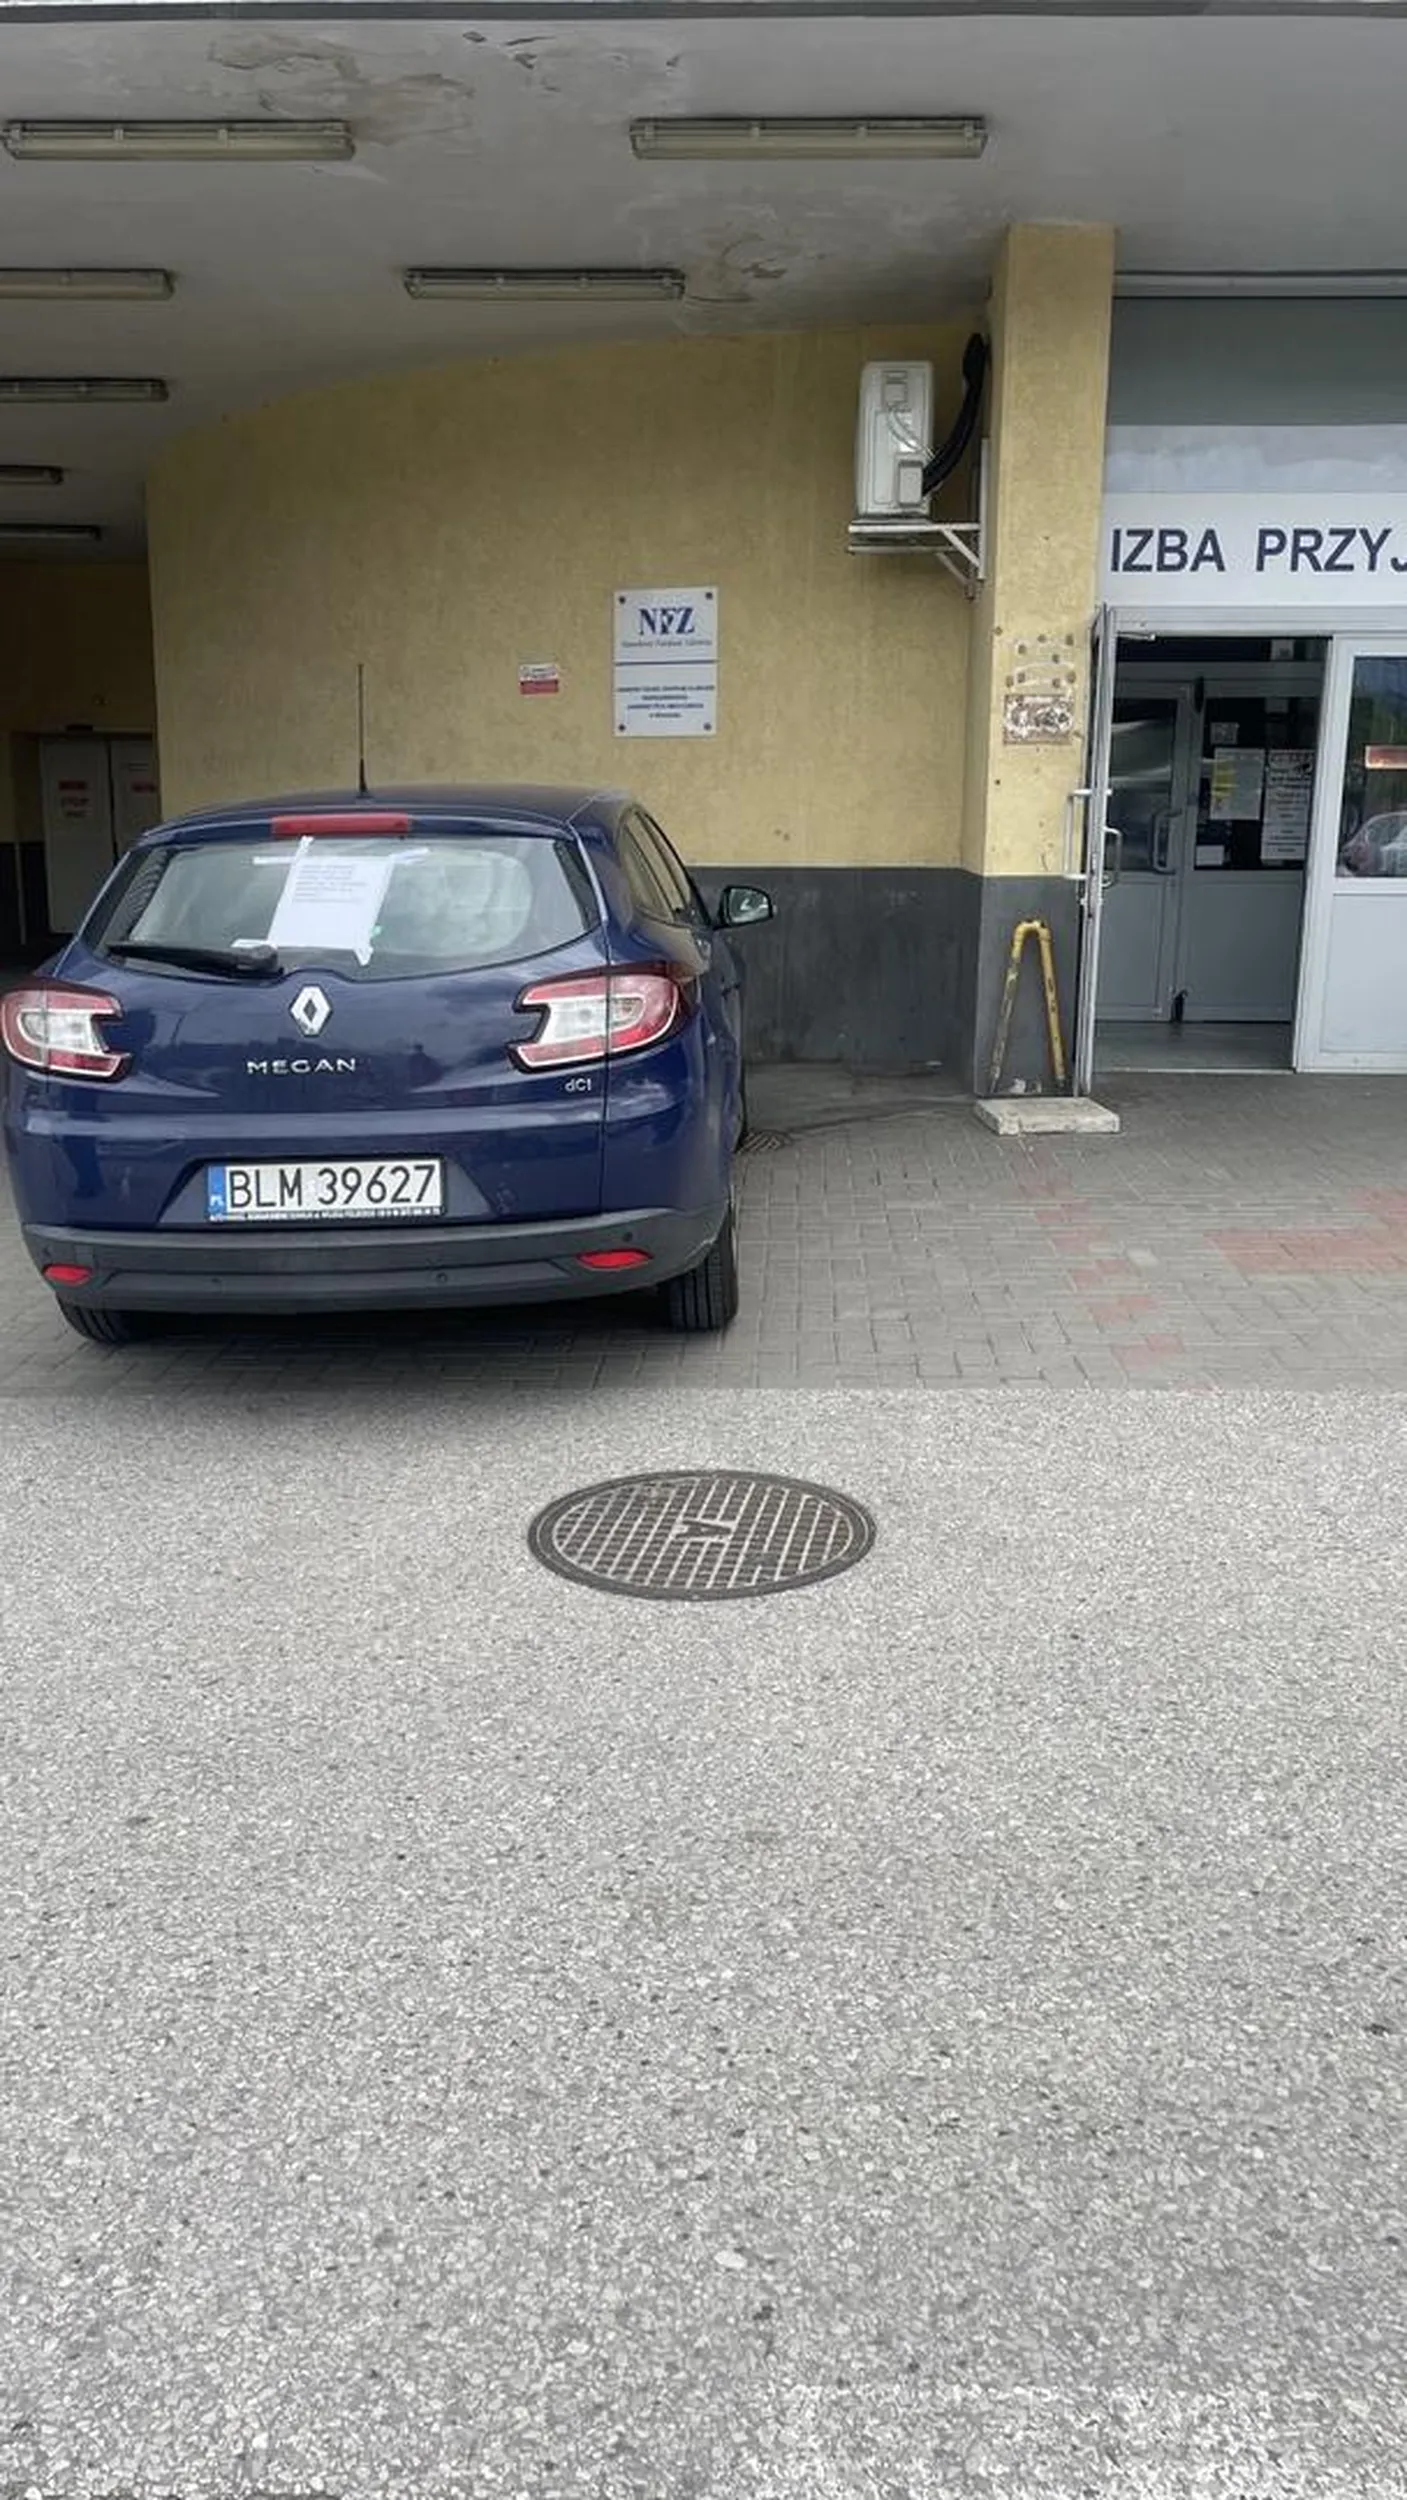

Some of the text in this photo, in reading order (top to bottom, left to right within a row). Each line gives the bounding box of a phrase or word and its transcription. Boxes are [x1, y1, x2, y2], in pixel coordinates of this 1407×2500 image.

[1111, 528, 1226, 573] IZBA
[638, 606, 695, 635] NFZ
[246, 1057, 356, 1075] MEGAN
[229, 1165, 436, 1208] BLM 39627
